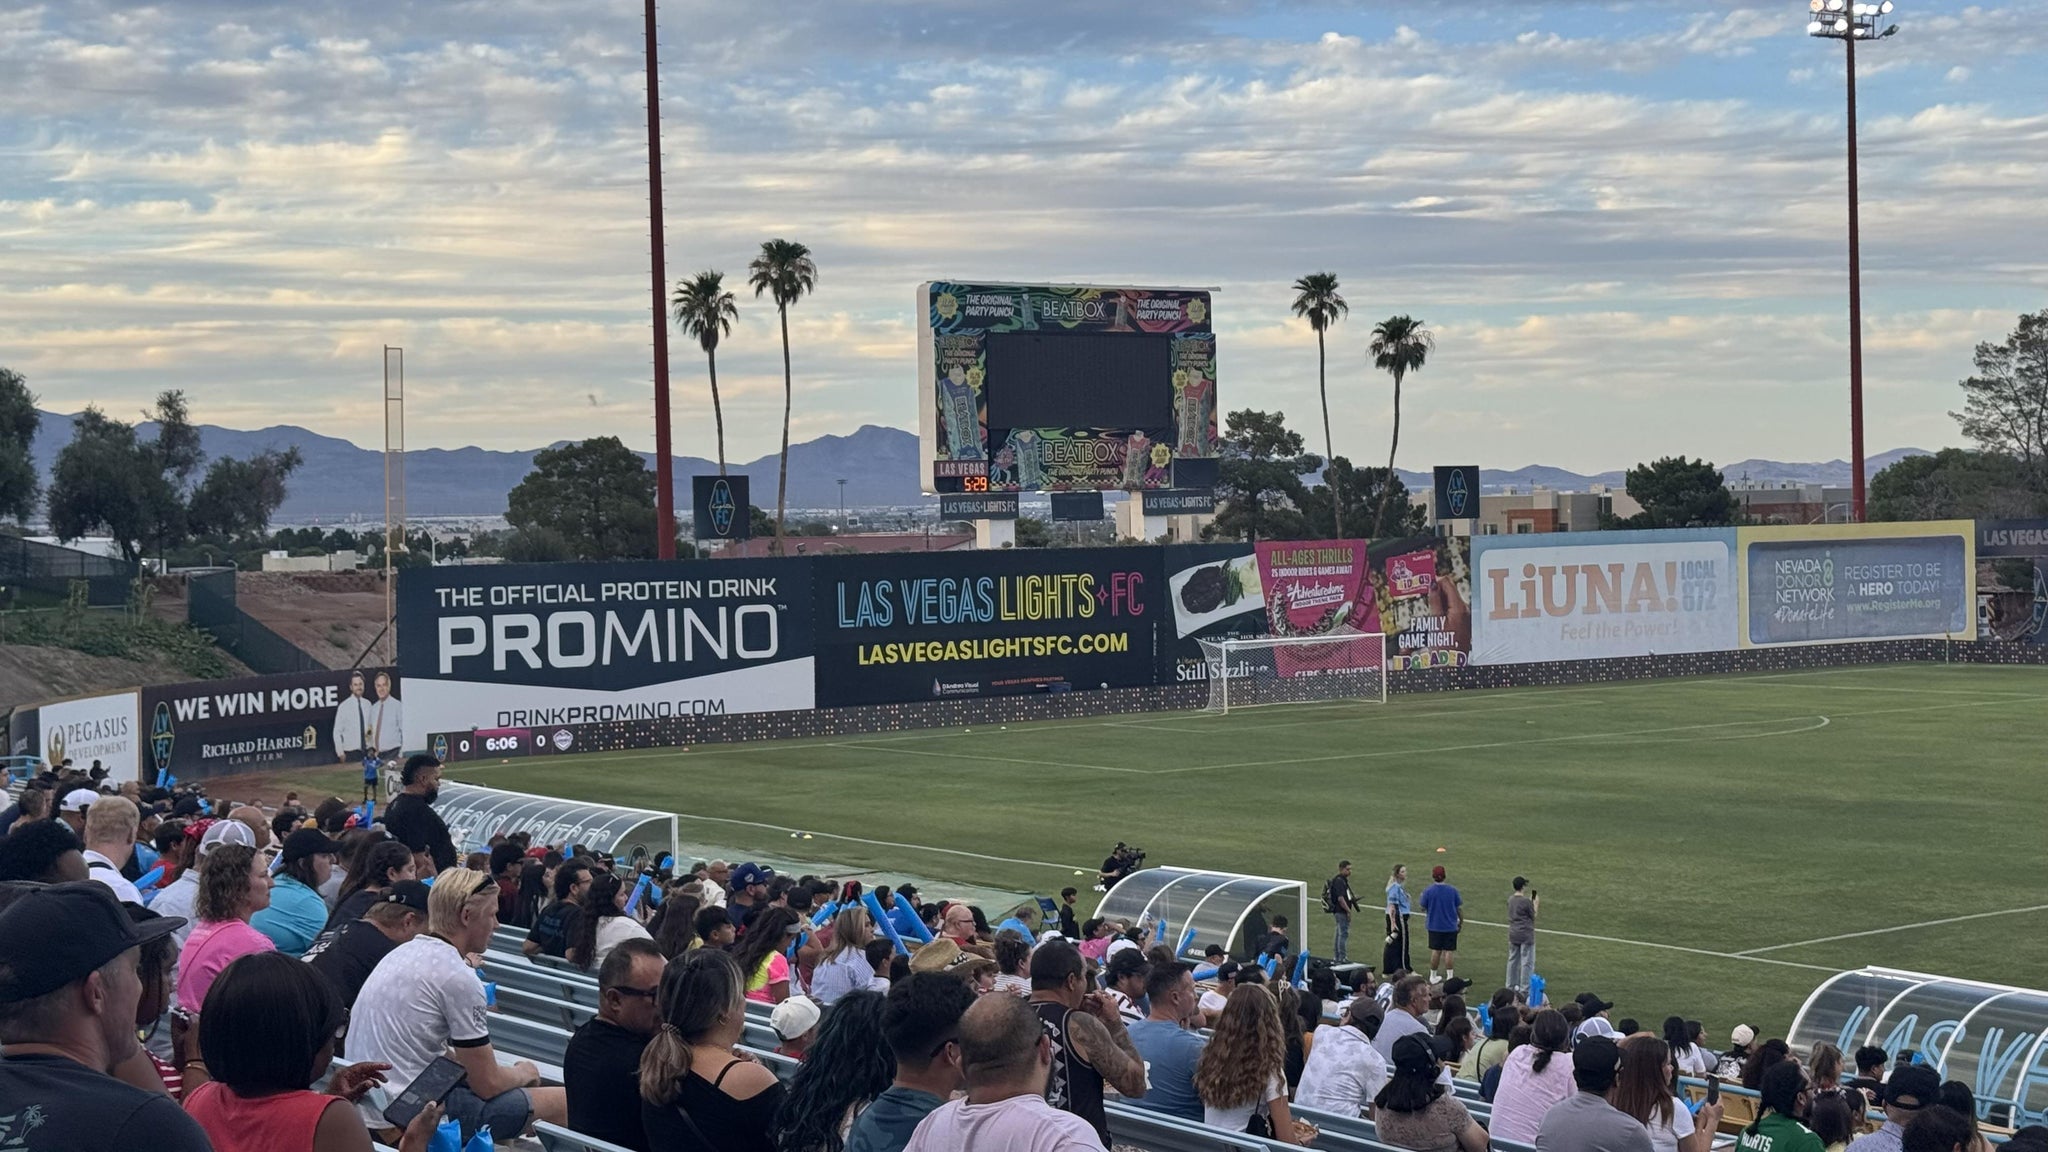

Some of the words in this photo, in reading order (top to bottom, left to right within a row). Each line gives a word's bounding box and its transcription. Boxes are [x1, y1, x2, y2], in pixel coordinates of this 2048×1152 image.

[966, 294, 980, 305] THE
[980, 295, 1013, 306] ORIGINAL
[1137, 299, 1150, 309] THE
[1150, 300, 1180, 310] ORIGINAL
[965, 306, 989, 316] PARTY
[988, 306, 1014, 317] PUNCH
[1043, 300, 1104, 317] BEATBOX
[1136, 310, 1158, 319] PARTY
[1158, 311, 1181, 320] PUNCH
[1042, 440, 1121, 464] BEATBOX
[940, 463, 956, 475] LAS
[958, 463, 985, 475] VEGAS
[964, 477, 987, 492] 5:29
[944, 502, 958, 514] LAS
[958, 501, 980, 513] VEGAS
[984, 500, 1006, 512] LIGHTS
[1007, 501, 1016, 512] FC
[1145, 498, 1158, 508] LAS
[1158, 497, 1178, 508] VEGAS
[1181, 496, 1202, 508] LIGHTS
[1203, 496, 1212, 507] FC
[716, 510, 729, 525] FC
[1984, 530, 2008, 546] LAS
[1271, 549, 1315, 566] ALL-AGES
[1316, 548, 1353, 564] THRILLS
[1279, 567, 1297, 577] INDOOR
[1300, 566, 1312, 576] RIDES
[1318, 566, 1335, 575] GAMES
[1680, 560, 1716, 580] LOCAL
[1775, 559, 1822, 574] NEVADA
[1844, 564, 1903, 580] REGISTER
[1906, 564, 1922, 578] TO
[1925, 563, 1941, 577] BE
[1776, 574, 1822, 589] DONOR
[1847, 584, 1856, 596] A
[1859, 582, 1894, 596] HERO
[1898, 580, 1940, 595] TODAY!
[435, 586, 484, 608] THE
[490, 583, 595, 606] OFFICIAL
[601, 580, 702, 602] PROTEIN
[708, 577, 777, 598] DRINK
[837, 578, 894, 628] LAS
[900, 576, 994, 626] VEGAS
[1000, 572, 1095, 622] LIGHTS
[1110, 570, 1144, 616] FC
[1488, 561, 1677, 621] LiUNA!
[1682, 580, 1718, 612] 872
[1776, 588, 1835, 603] NETWORK
[1411, 616, 1447, 632] FAMILY
[1560, 622, 1592, 642] Feel
[1596, 620, 1618, 638] the
[1624, 618, 1678, 638] Power!
[1398, 633, 1426, 648] GAME
[1428, 632, 1458, 648] NIGHT,
[858, 632, 1128, 666] LASVEGASLIGHTSFC.COM
[1176, 662, 1207, 682] Still
[174, 696, 210, 722] WE
[215, 692, 264, 718] WIN
[271, 685, 338, 713] MORE
[497, 698, 725, 729] DRINKPROMINO.COM
[68, 716, 128, 744] PEGASUS
[202, 741, 255, 758] RICHARD
[257, 736, 303, 752] HARRIS
[460, 740, 470, 752] 0
[486, 736, 518, 751] 6:06
[536, 735, 546, 747] 0
[69, 741, 127, 760] DEVELOPMENT
[229, 756, 250, 765] LAW
[256, 752, 283, 762] FIRM
